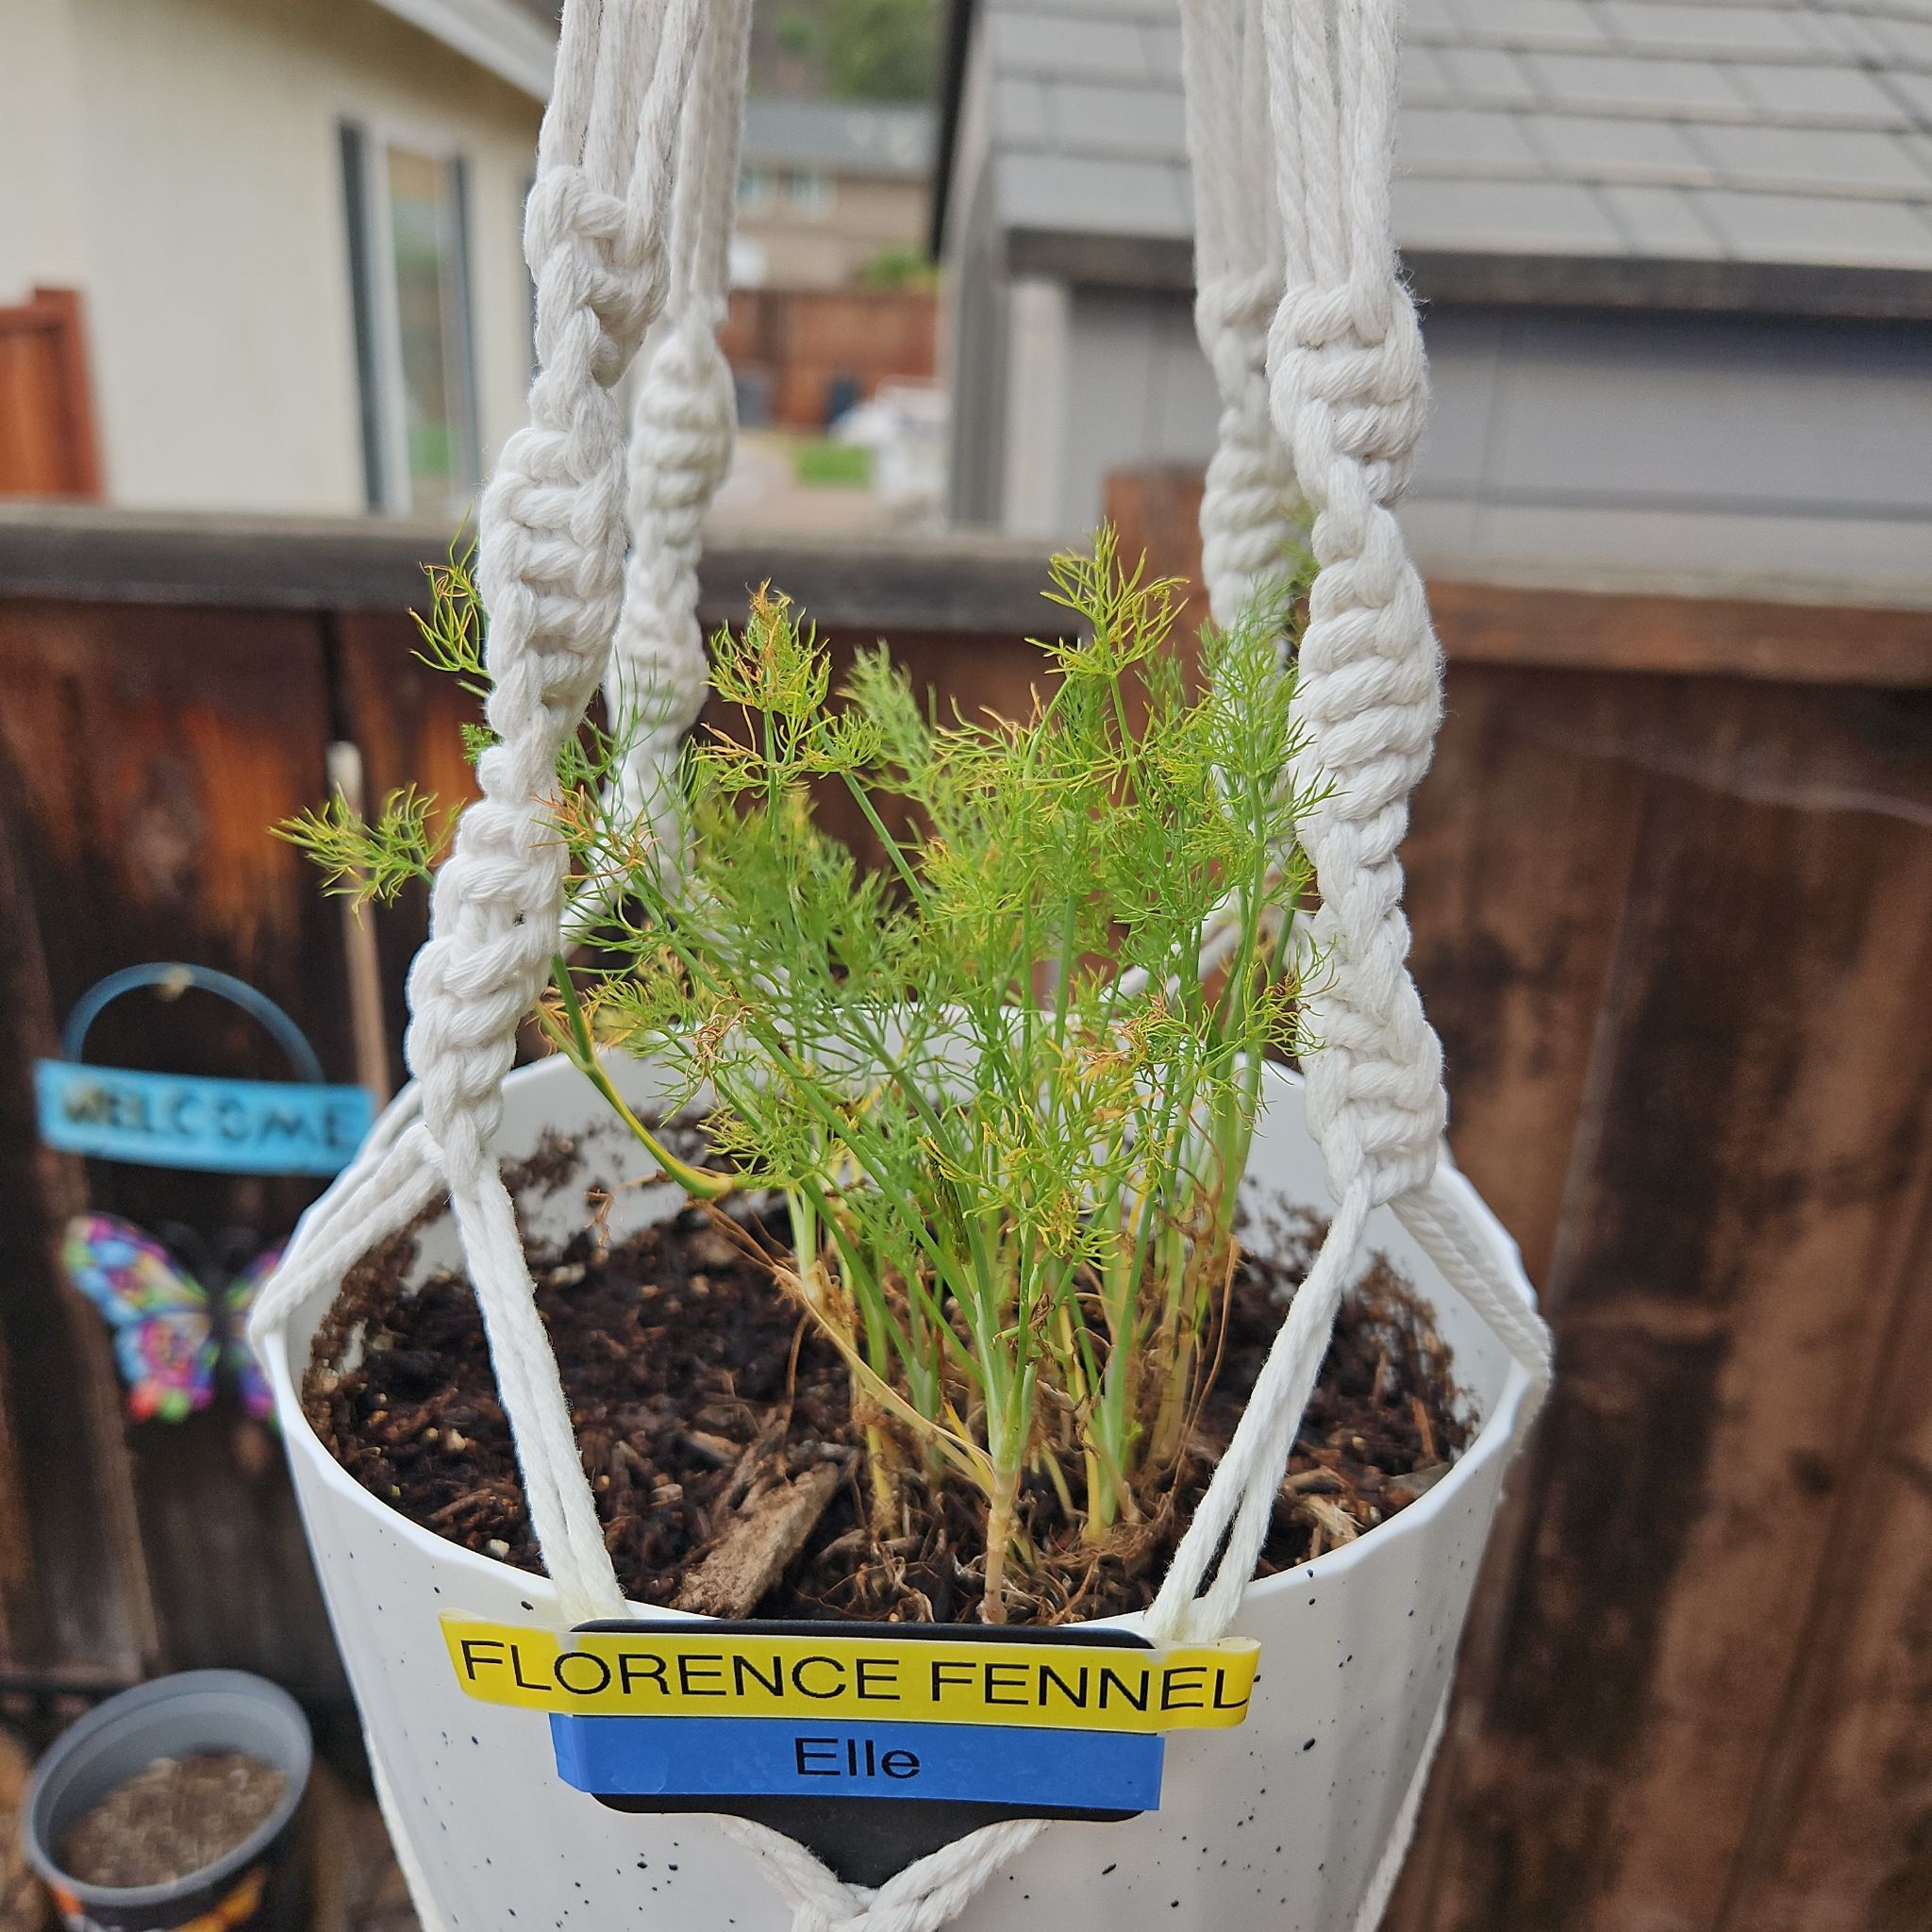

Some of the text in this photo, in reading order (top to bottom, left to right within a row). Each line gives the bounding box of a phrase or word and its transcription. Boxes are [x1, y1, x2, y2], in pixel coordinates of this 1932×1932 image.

[62, 1084, 355, 1148] WELCOME
[459, 1640, 1250, 1712] FLORENCE FENNEL
[795, 1737, 922, 1780] Elle
